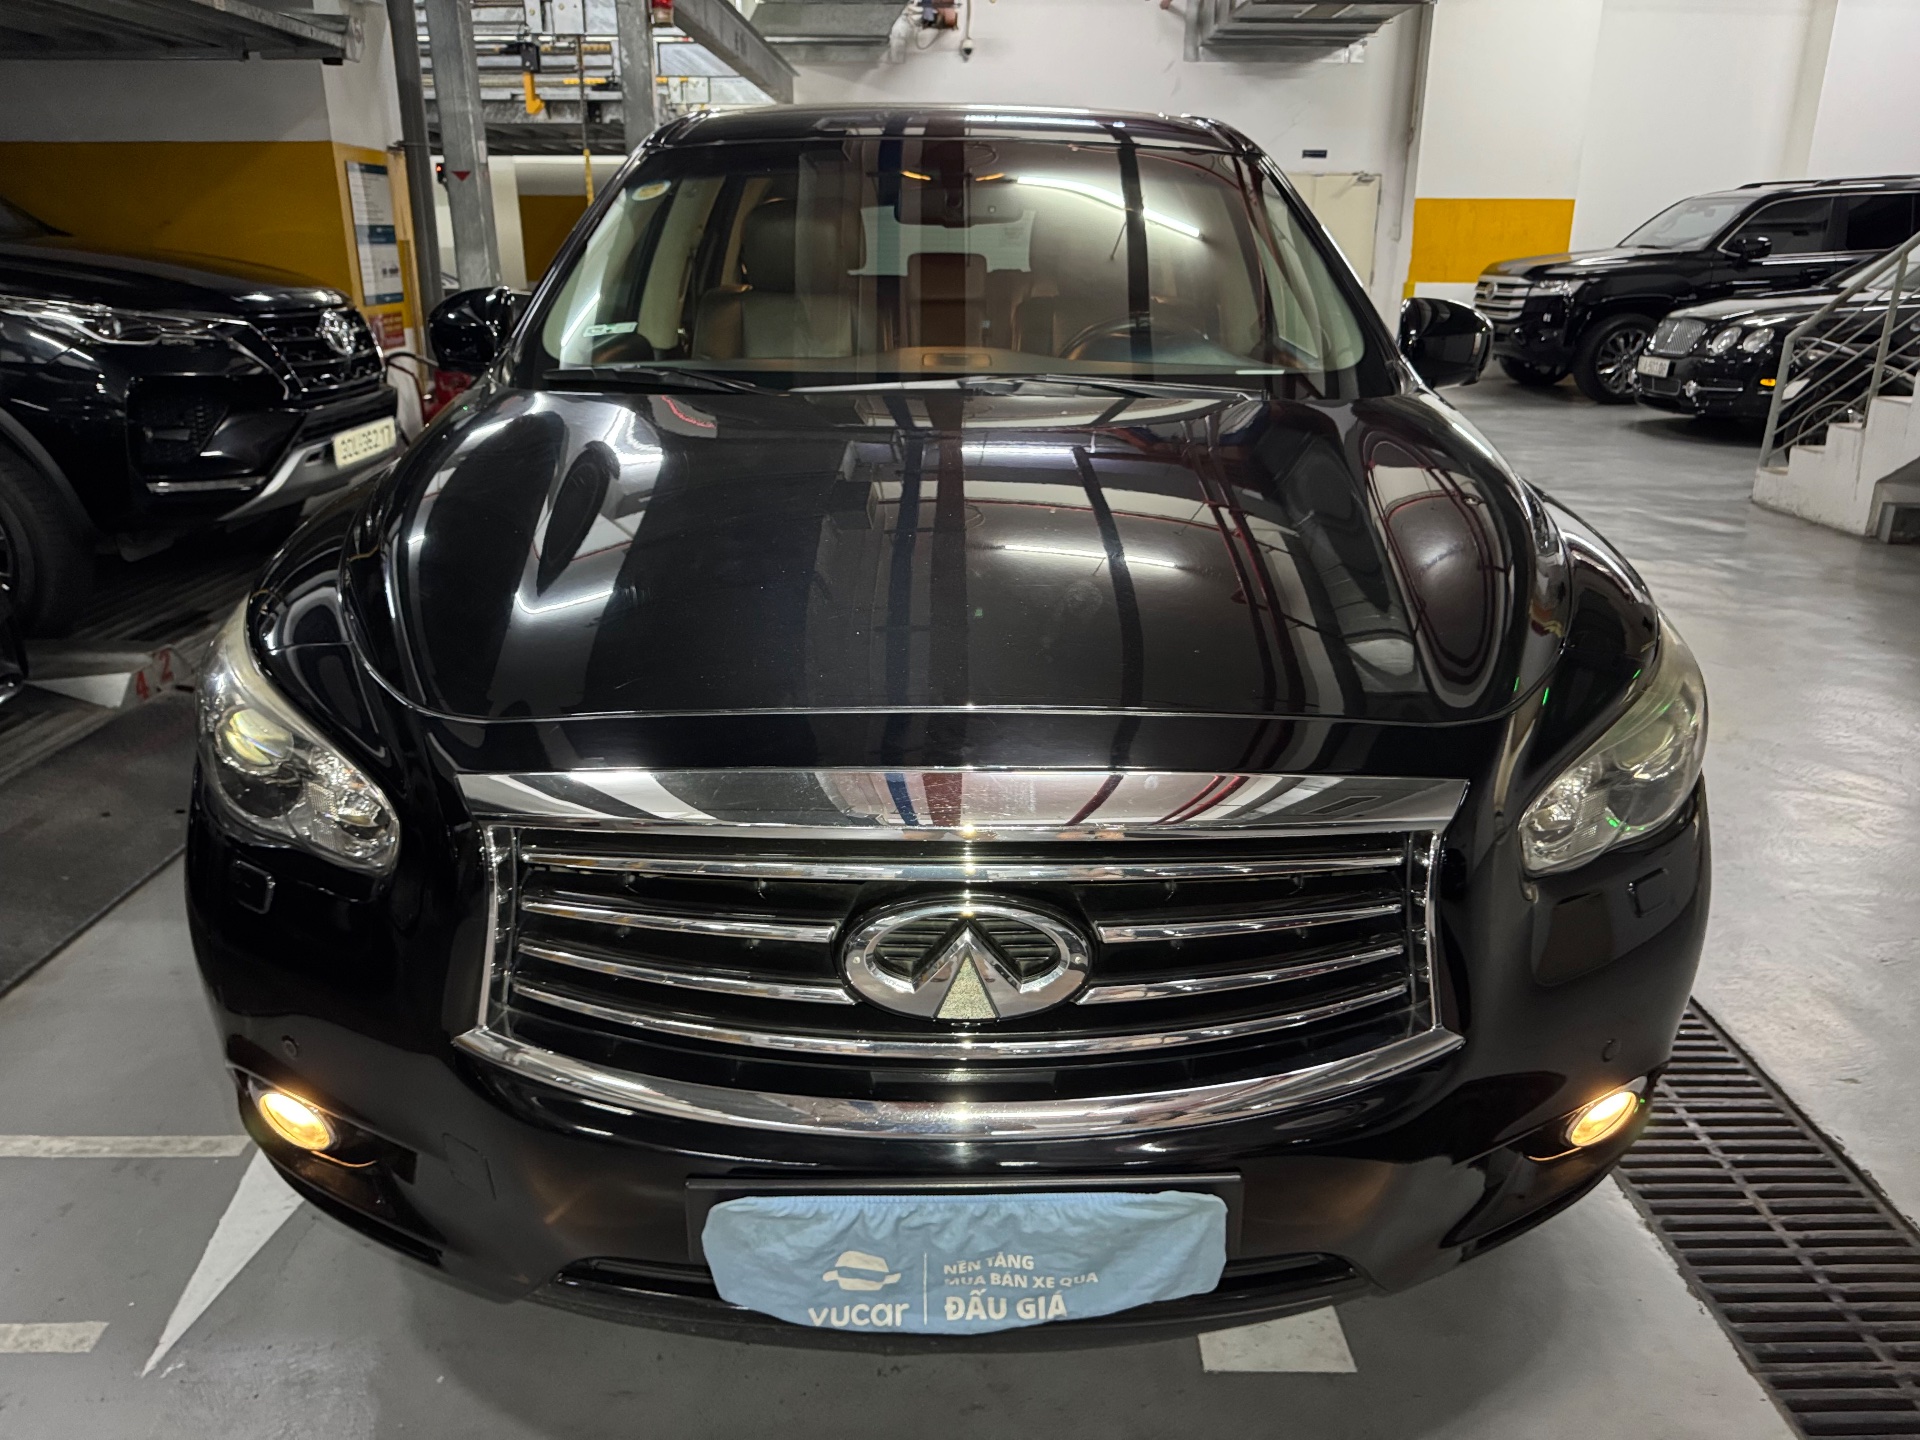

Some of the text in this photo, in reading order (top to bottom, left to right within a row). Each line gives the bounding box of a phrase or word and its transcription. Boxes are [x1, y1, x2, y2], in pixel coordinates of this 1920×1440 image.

[943, 1251, 1035, 1275] NỀN TẢNG
[944, 1271, 1099, 1289] MUA BÁN XE QUA
[808, 1303, 910, 1327] vucar
[944, 1288, 1068, 1321] ĐẤU GIÁ
